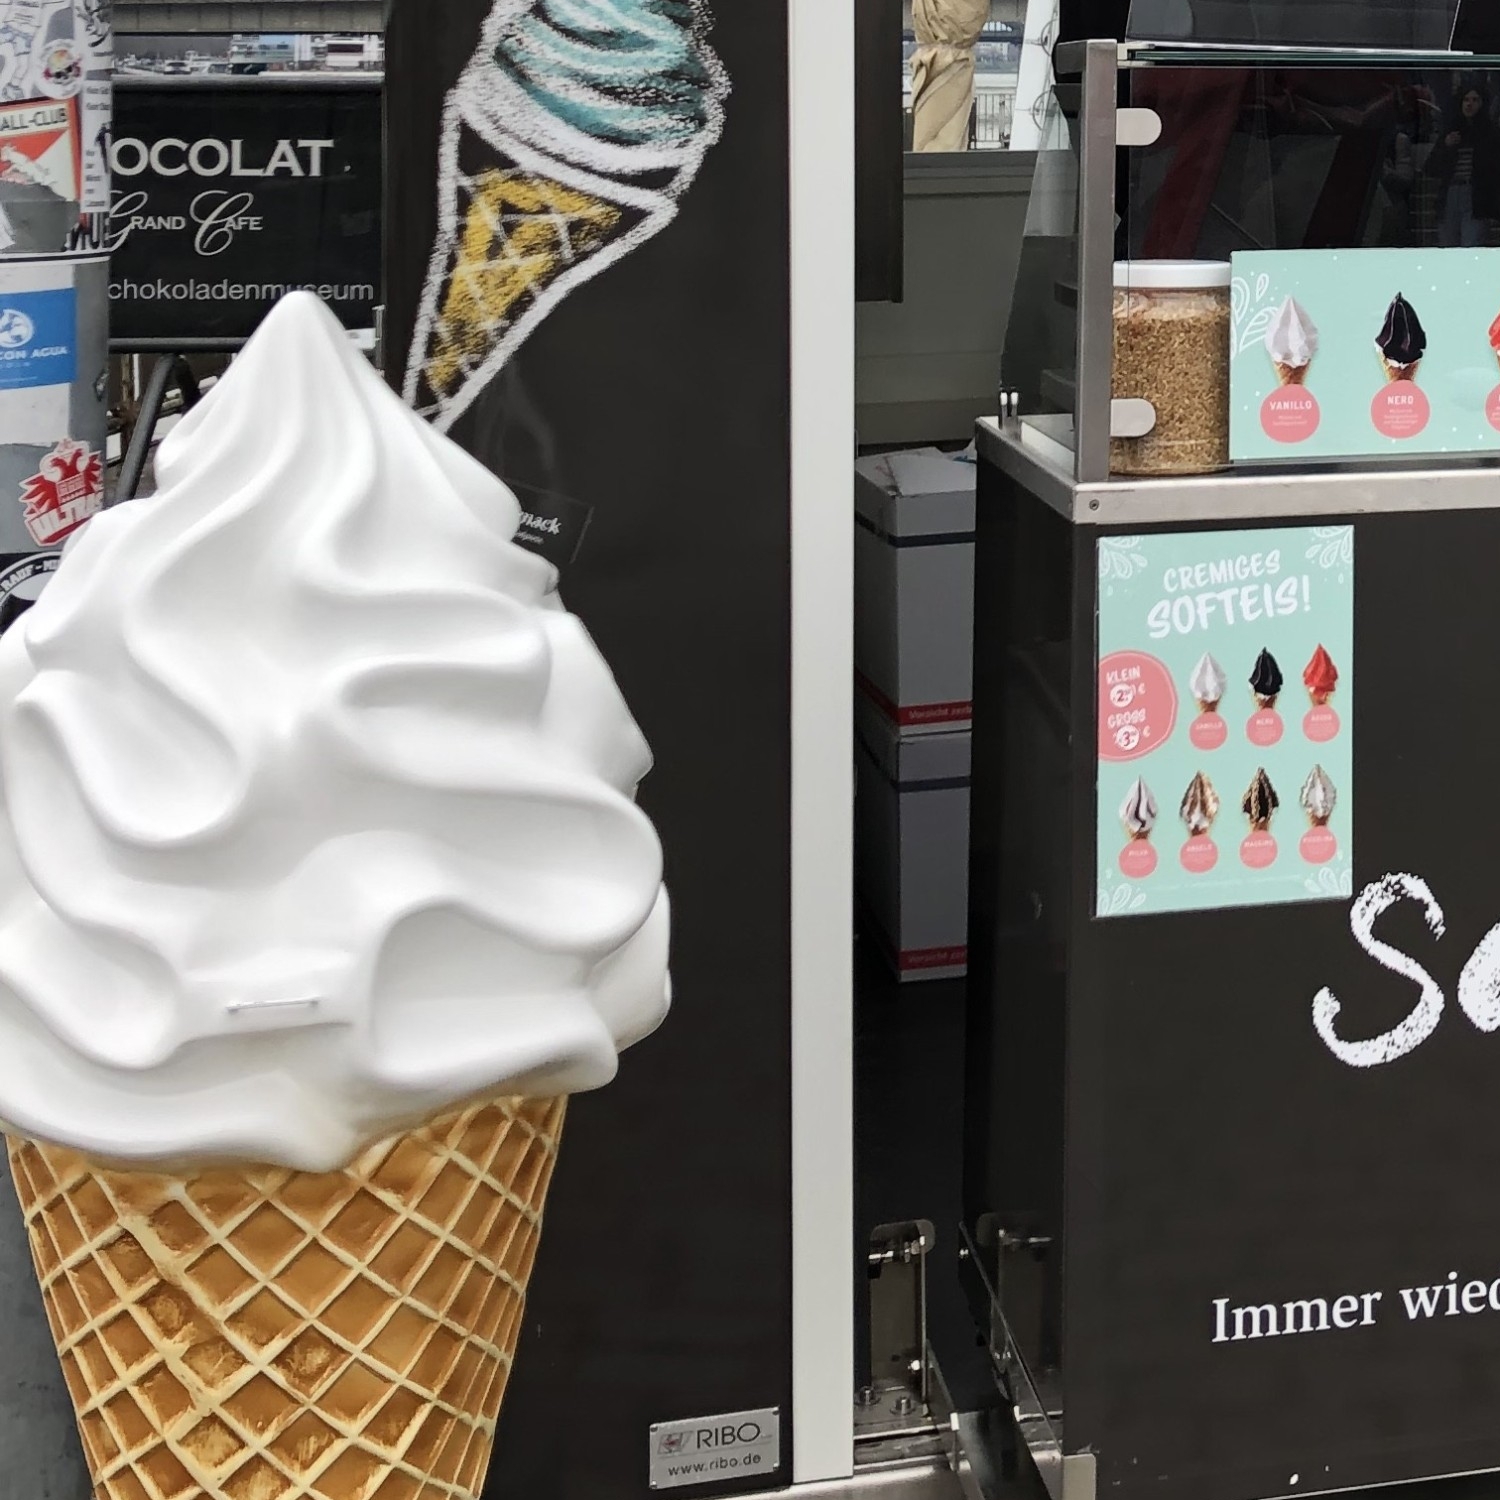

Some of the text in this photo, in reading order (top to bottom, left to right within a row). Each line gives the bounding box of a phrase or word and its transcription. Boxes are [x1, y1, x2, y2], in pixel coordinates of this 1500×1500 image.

[108, 278, 374, 301] chokoladenmeum
[1269, 400, 1312, 411] VANILLO
[1163, 549, 1281, 593] CREMIGES
[1147, 573, 1312, 639] SOFTEIS!
[1211, 1284, 1383, 1344] Immer
[696, 1422, 761, 1449] RIBO
[667, 1453, 762, 1477] www.ribo.de
